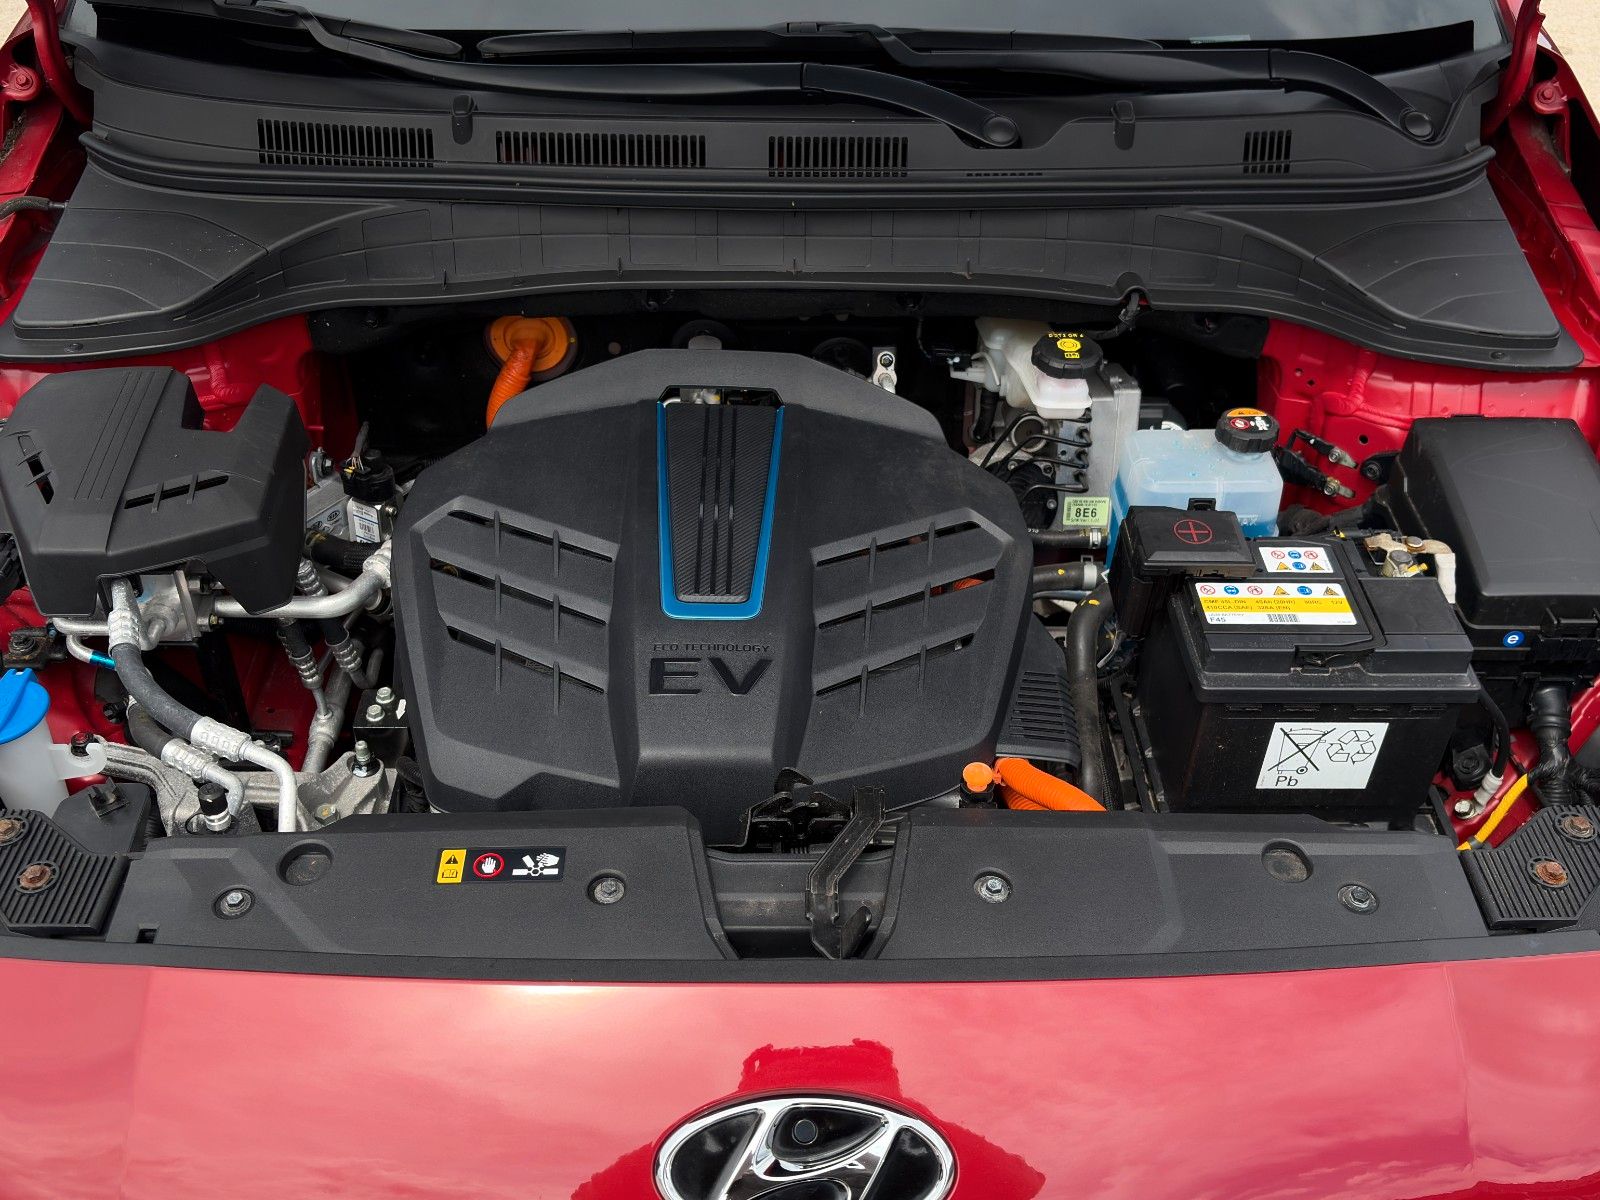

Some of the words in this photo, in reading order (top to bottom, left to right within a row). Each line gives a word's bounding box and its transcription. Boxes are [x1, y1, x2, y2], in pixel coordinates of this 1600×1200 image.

[1075, 507, 1097, 518] 8E6
[1507, 634, 1519, 645] e
[653, 643, 679, 652] ECO
[685, 643, 770, 653] TECHNOLOGY
[649, 657, 774, 696] EV
[1275, 775, 1299, 787] Pb
